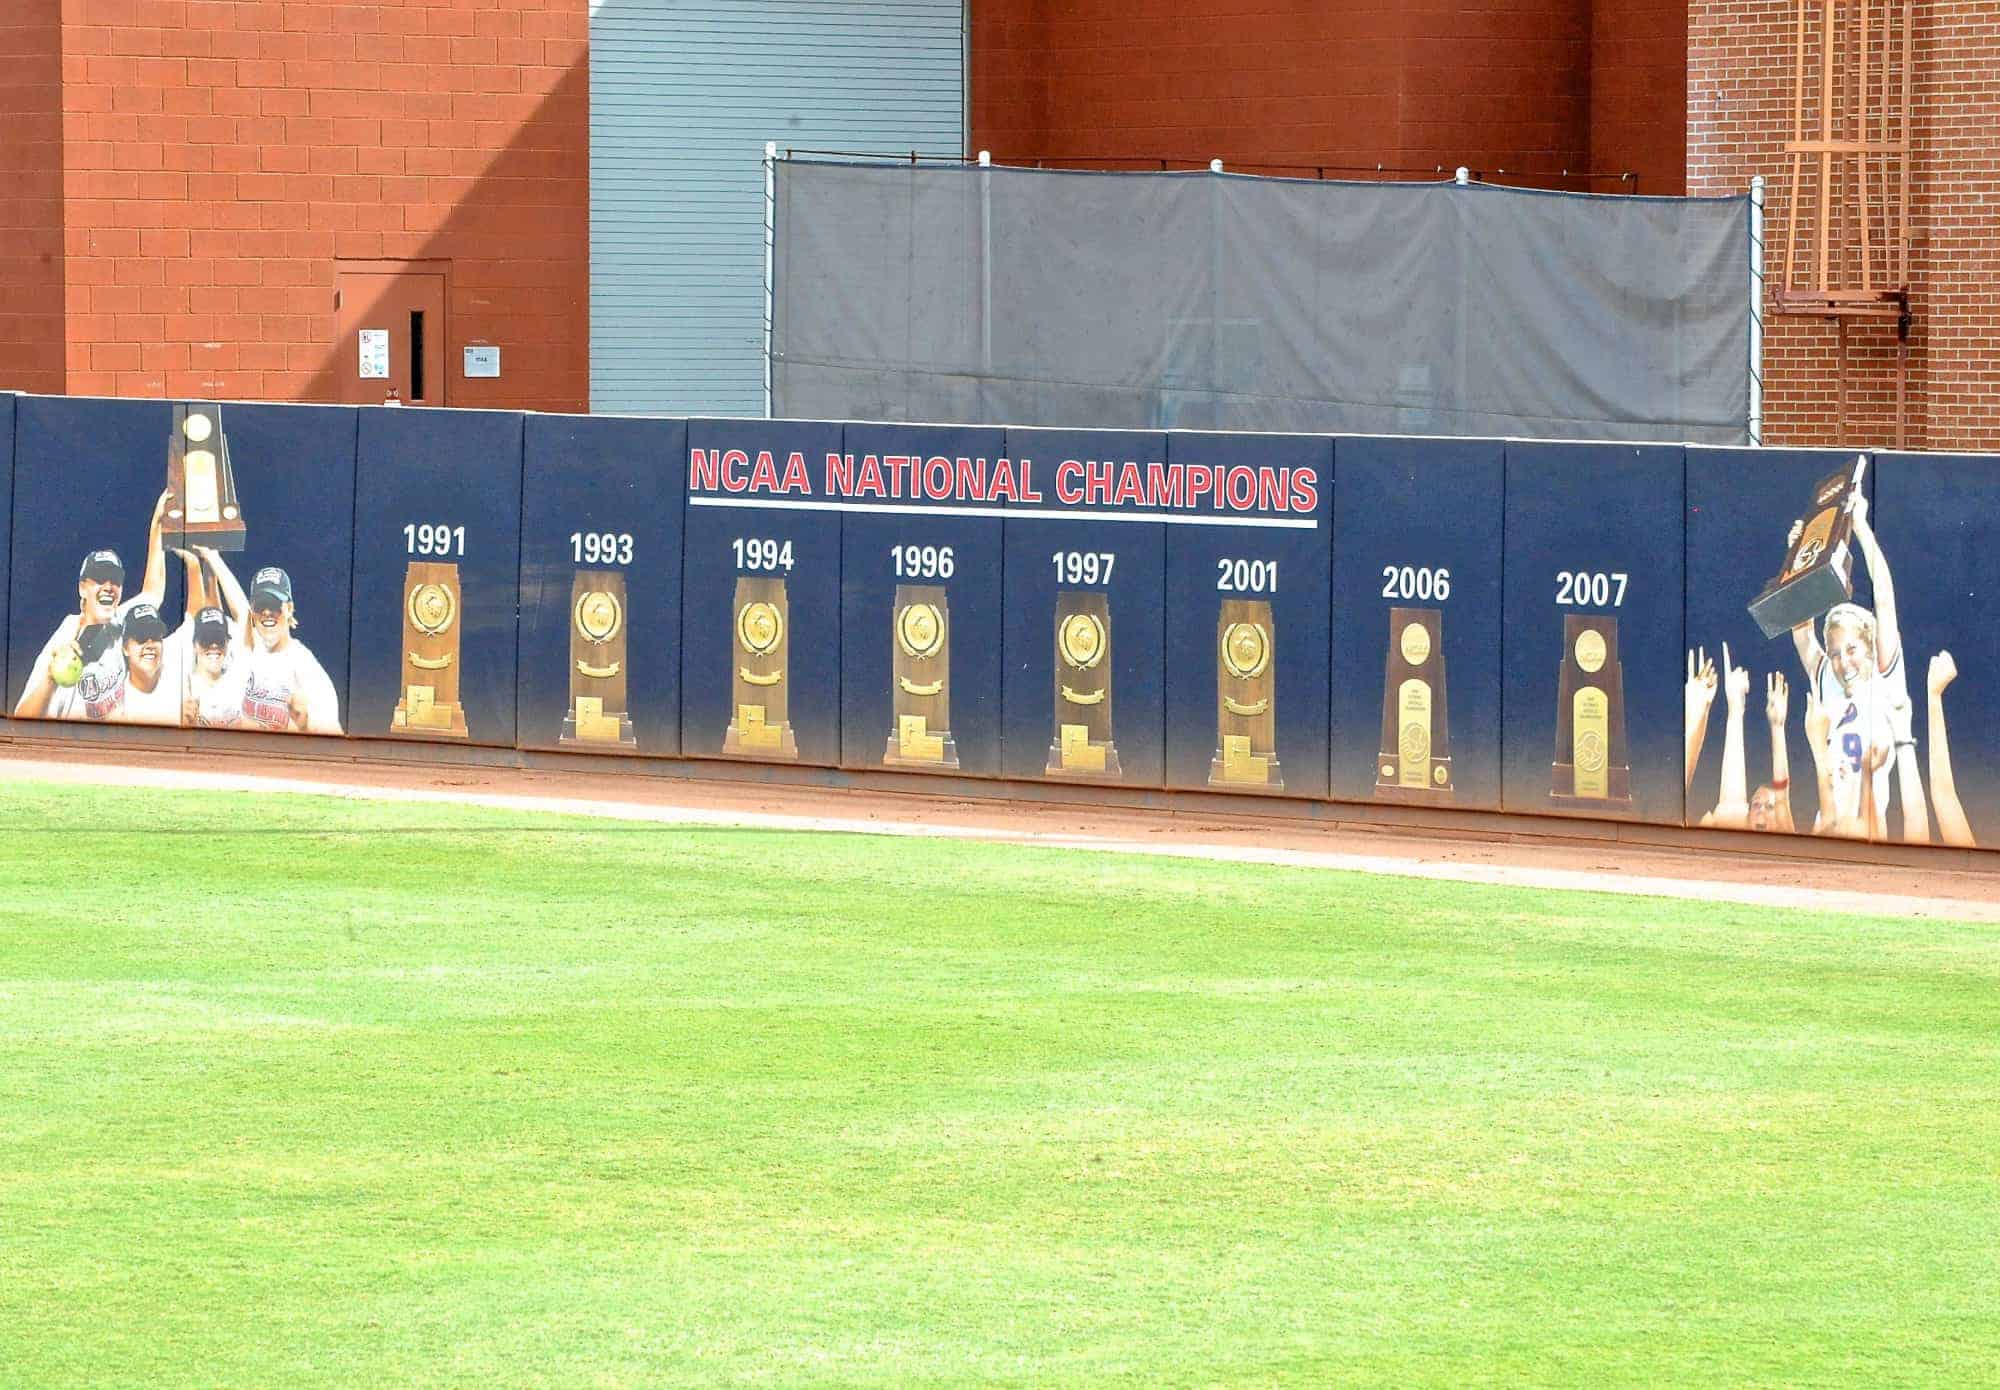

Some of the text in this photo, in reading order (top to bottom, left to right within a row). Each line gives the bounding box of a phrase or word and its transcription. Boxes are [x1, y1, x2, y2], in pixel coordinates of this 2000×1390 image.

[689, 449, 1318, 512] NCAA NATIONAL CHAMPIONS
[403, 523, 465, 557] 1991
[570, 532, 634, 565] 1993
[732, 538, 795, 571] 1994
[891, 545, 954, 578] 1996
[1052, 551, 1115, 585] 1997
[1217, 558, 1279, 593] 2001
[1382, 565, 1450, 601] 2006
[1555, 571, 1628, 607] 2007
